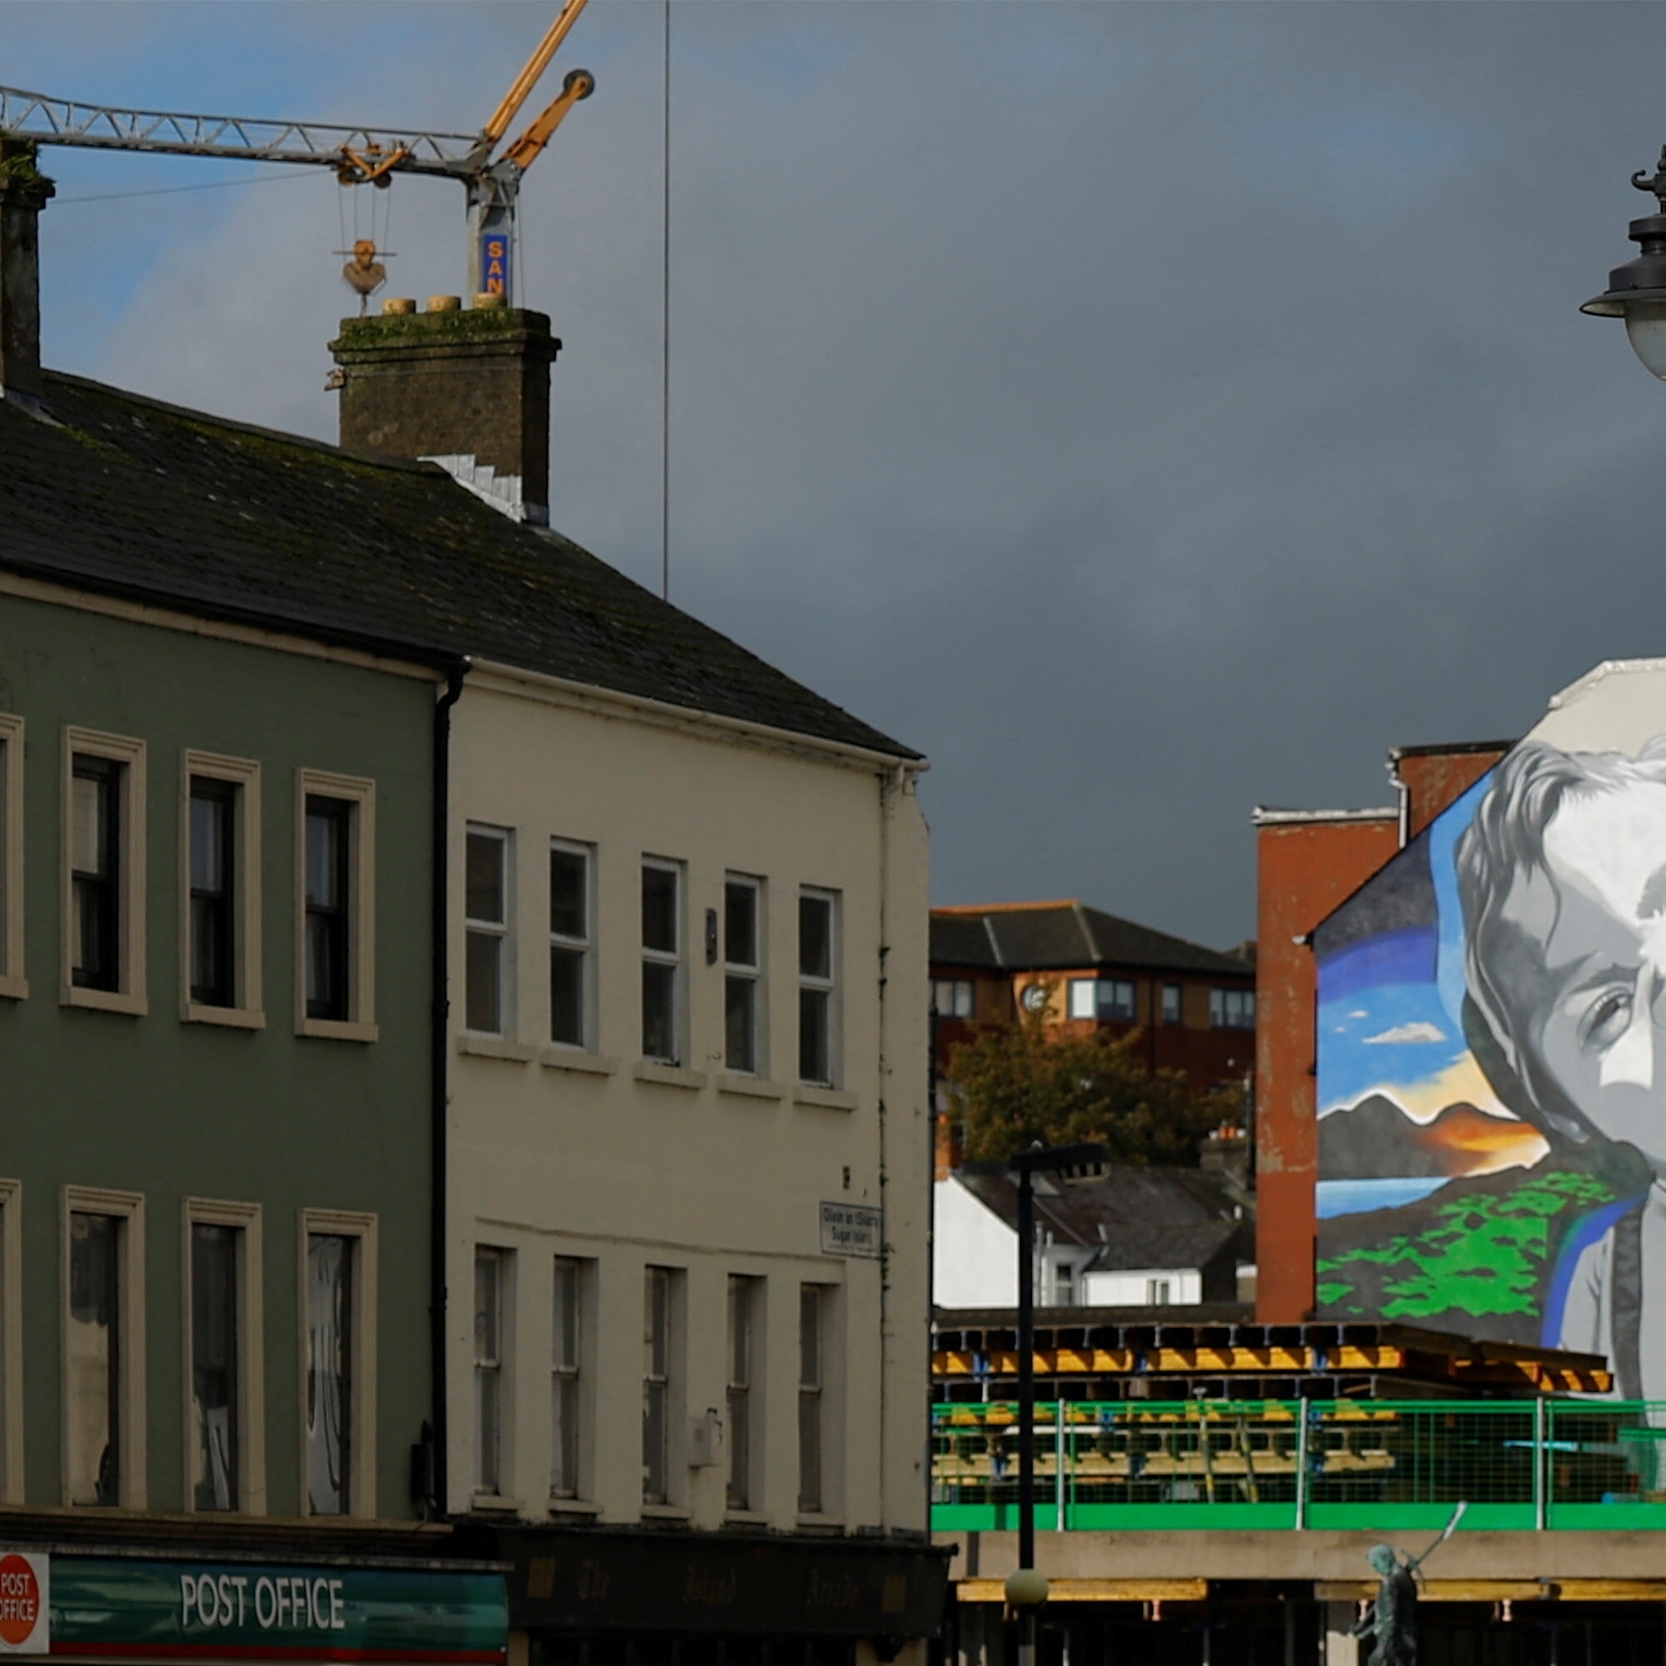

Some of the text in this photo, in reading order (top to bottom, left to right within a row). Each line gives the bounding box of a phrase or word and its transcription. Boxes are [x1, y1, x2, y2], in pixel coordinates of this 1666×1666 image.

[1, 1573, 31, 1597] POST
[179, 1574, 345, 1631] POST OFFICE
